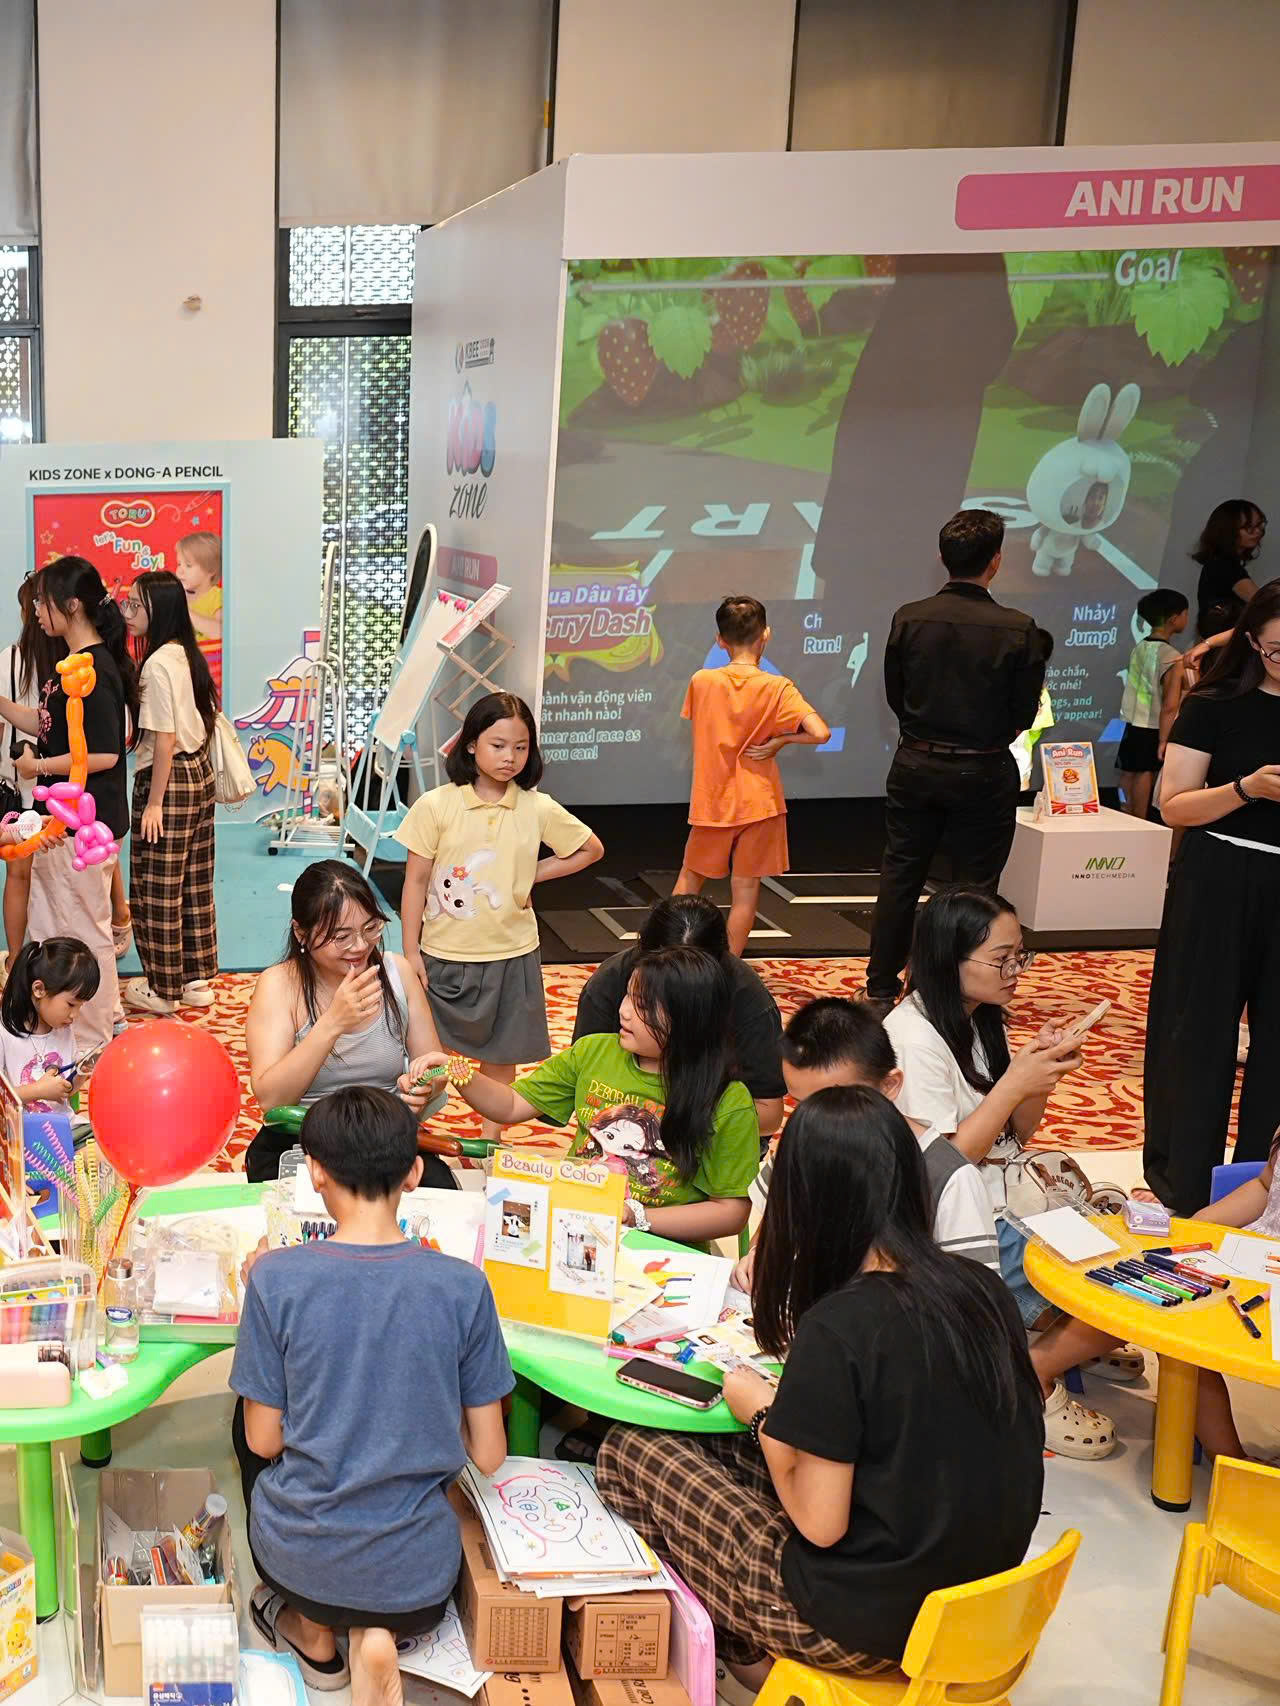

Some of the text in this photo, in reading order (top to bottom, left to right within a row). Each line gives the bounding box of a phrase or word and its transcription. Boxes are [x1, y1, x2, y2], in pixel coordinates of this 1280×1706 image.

[1064, 176, 1245, 217] ANI RUN
[1115, 250, 1184, 287] Goal
[29, 469, 61, 480] KIDS
[64, 468, 101, 480] ZONE
[115, 467, 172, 479] DONG-A
[175, 466, 223, 477] PENCIL
[449, 482, 487, 520] zone
[114, 538, 141, 552] Fun
[132, 553, 164, 571] Joy!
[548, 584, 649, 606] ua Dâu Tây
[590, 607, 653, 637] Dash
[803, 635, 842, 654] Run!
[1065, 627, 1118, 648] Jump!
[1051, 696, 1092, 709] ogs, and
[555, 708, 593, 721] nhanh
[1064, 709, 1102, 721] appear!
[569, 727, 595, 743] and
[596, 731, 624, 743] race
[625, 730, 641, 742] as
[544, 745, 598, 764] you can!
[1052, 748, 1084, 758] Ani Run
[1085, 856, 1126, 870] INNO
[502, 1154, 606, 1184] Beauty Color
